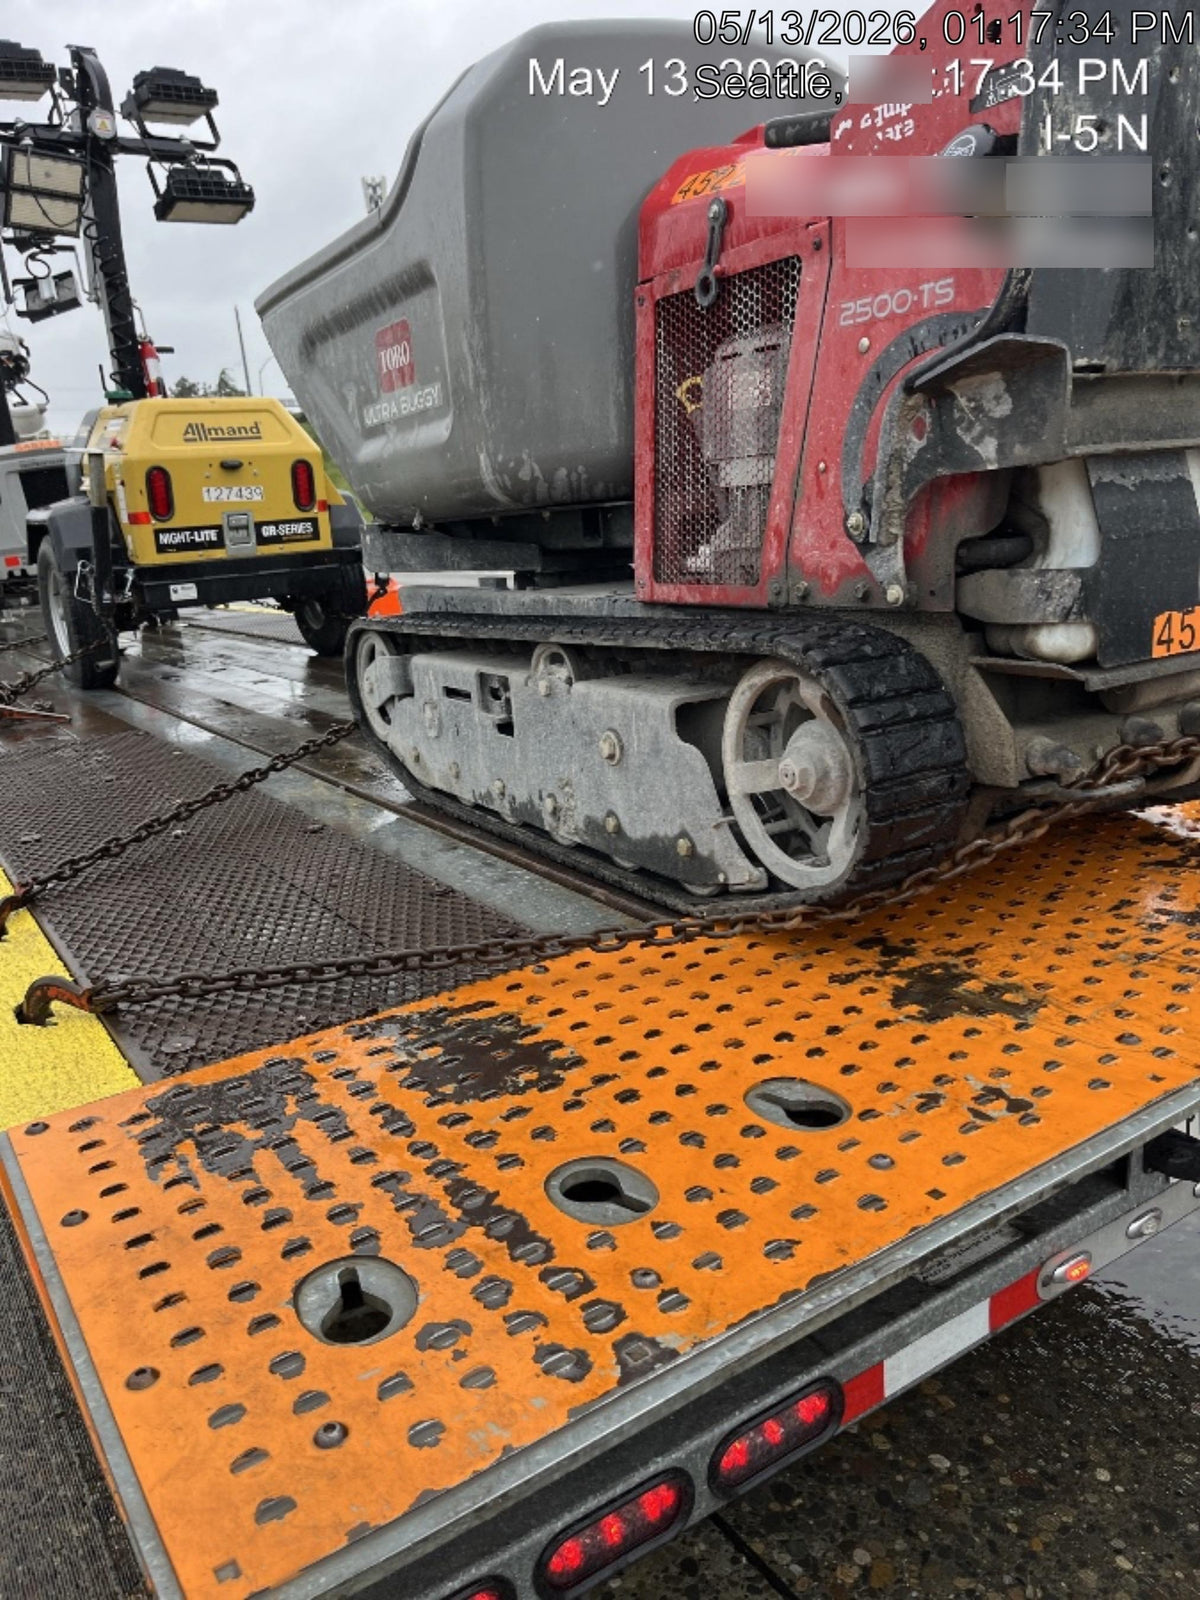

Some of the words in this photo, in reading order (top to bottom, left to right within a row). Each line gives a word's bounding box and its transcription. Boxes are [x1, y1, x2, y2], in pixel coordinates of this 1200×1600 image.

[380, 340, 411, 374] TORO
[363, 402, 399, 427] ULTRA
[400, 384, 441, 417] BUGGY
[183, 421, 262, 442] Allmand
[206, 486, 263, 501] 127439
[158, 529, 219, 545] NIGHT-LITE
